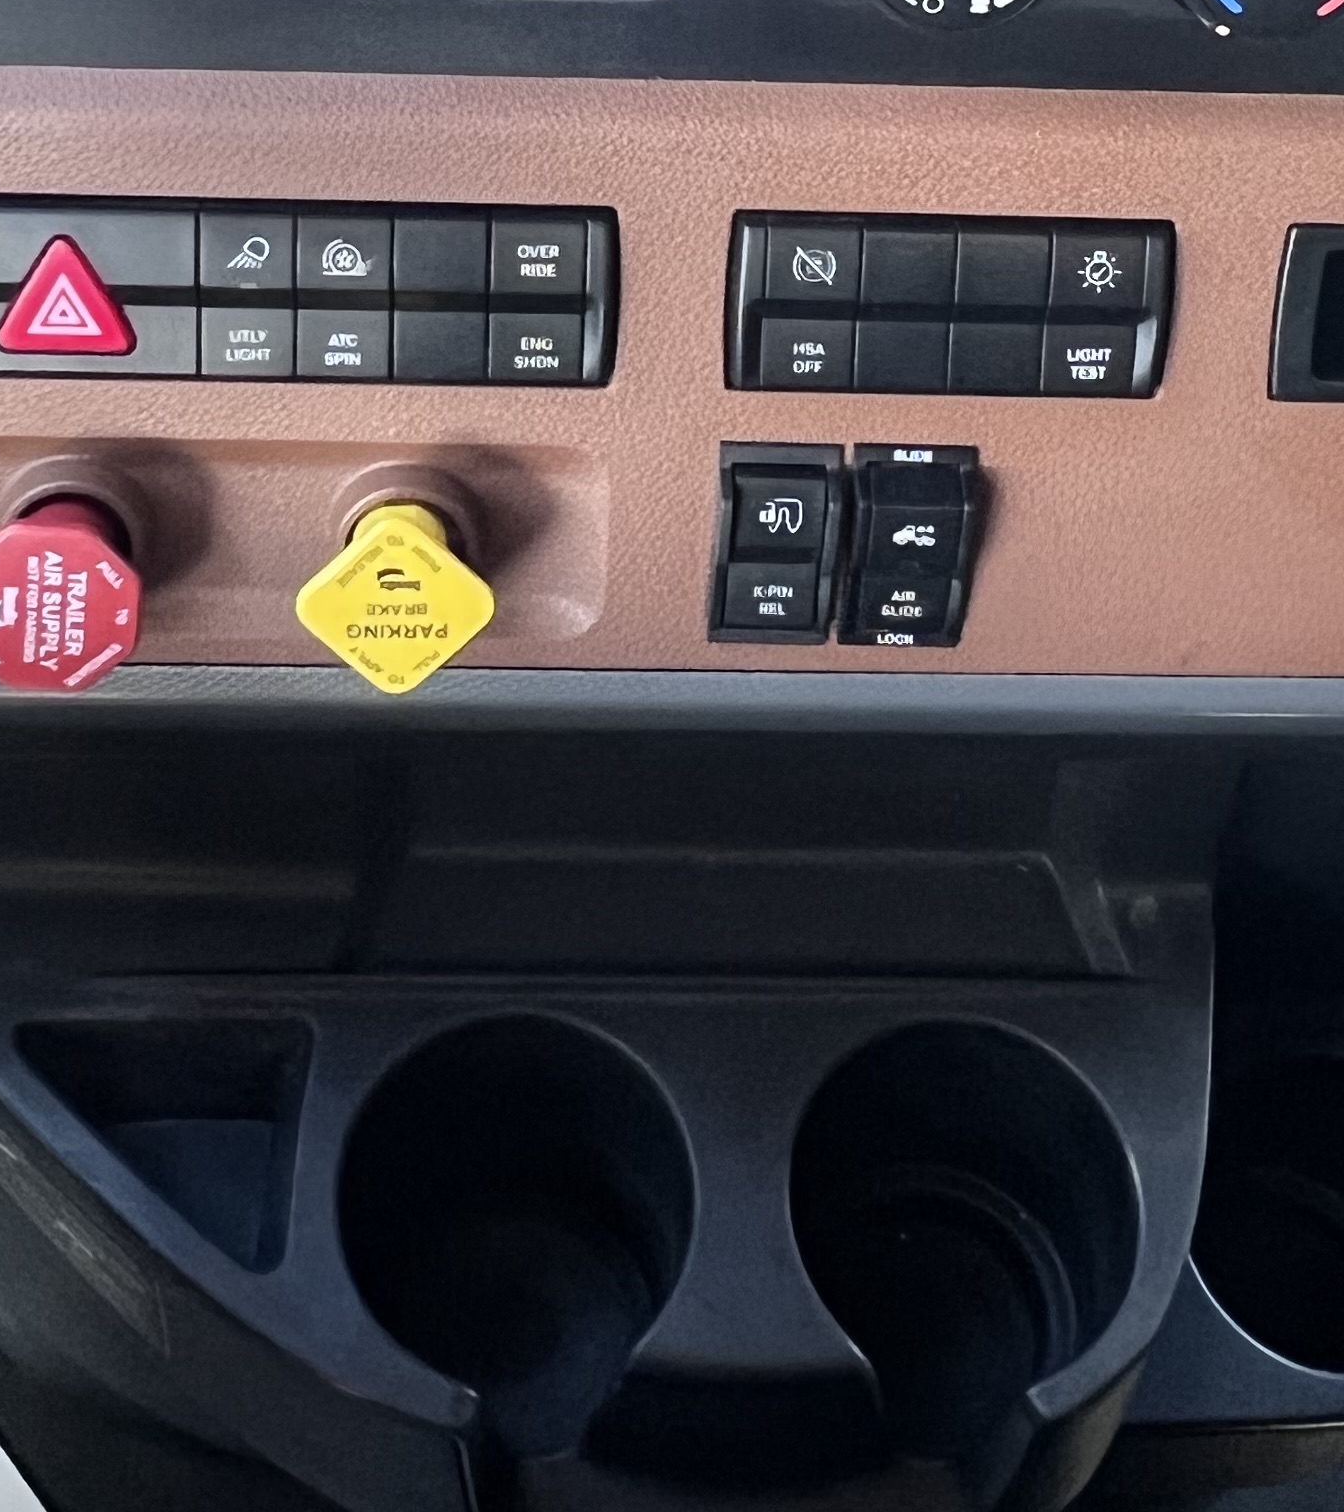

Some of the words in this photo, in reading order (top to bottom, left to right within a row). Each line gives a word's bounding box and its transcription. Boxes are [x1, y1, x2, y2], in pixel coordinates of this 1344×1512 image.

[517, 244, 560, 259] OVER
[520, 263, 557, 277] RIDE
[327, 333, 359, 348] ATC
[520, 336, 553, 351] ENG
[225, 348, 271, 362] LIGHT
[324, 352, 362, 366] SPIN
[1066, 348, 1112, 362] LIGHT
[792, 360, 824, 374] OFF
[1070, 365, 1107, 380] TEST
[43, 551, 64, 586] AIR
[63, 571, 88, 656] TRAILER
[366, 602, 428, 616] BRAKE
[39, 591, 62, 672] SUPPLY
[346, 623, 449, 639] PARKING
